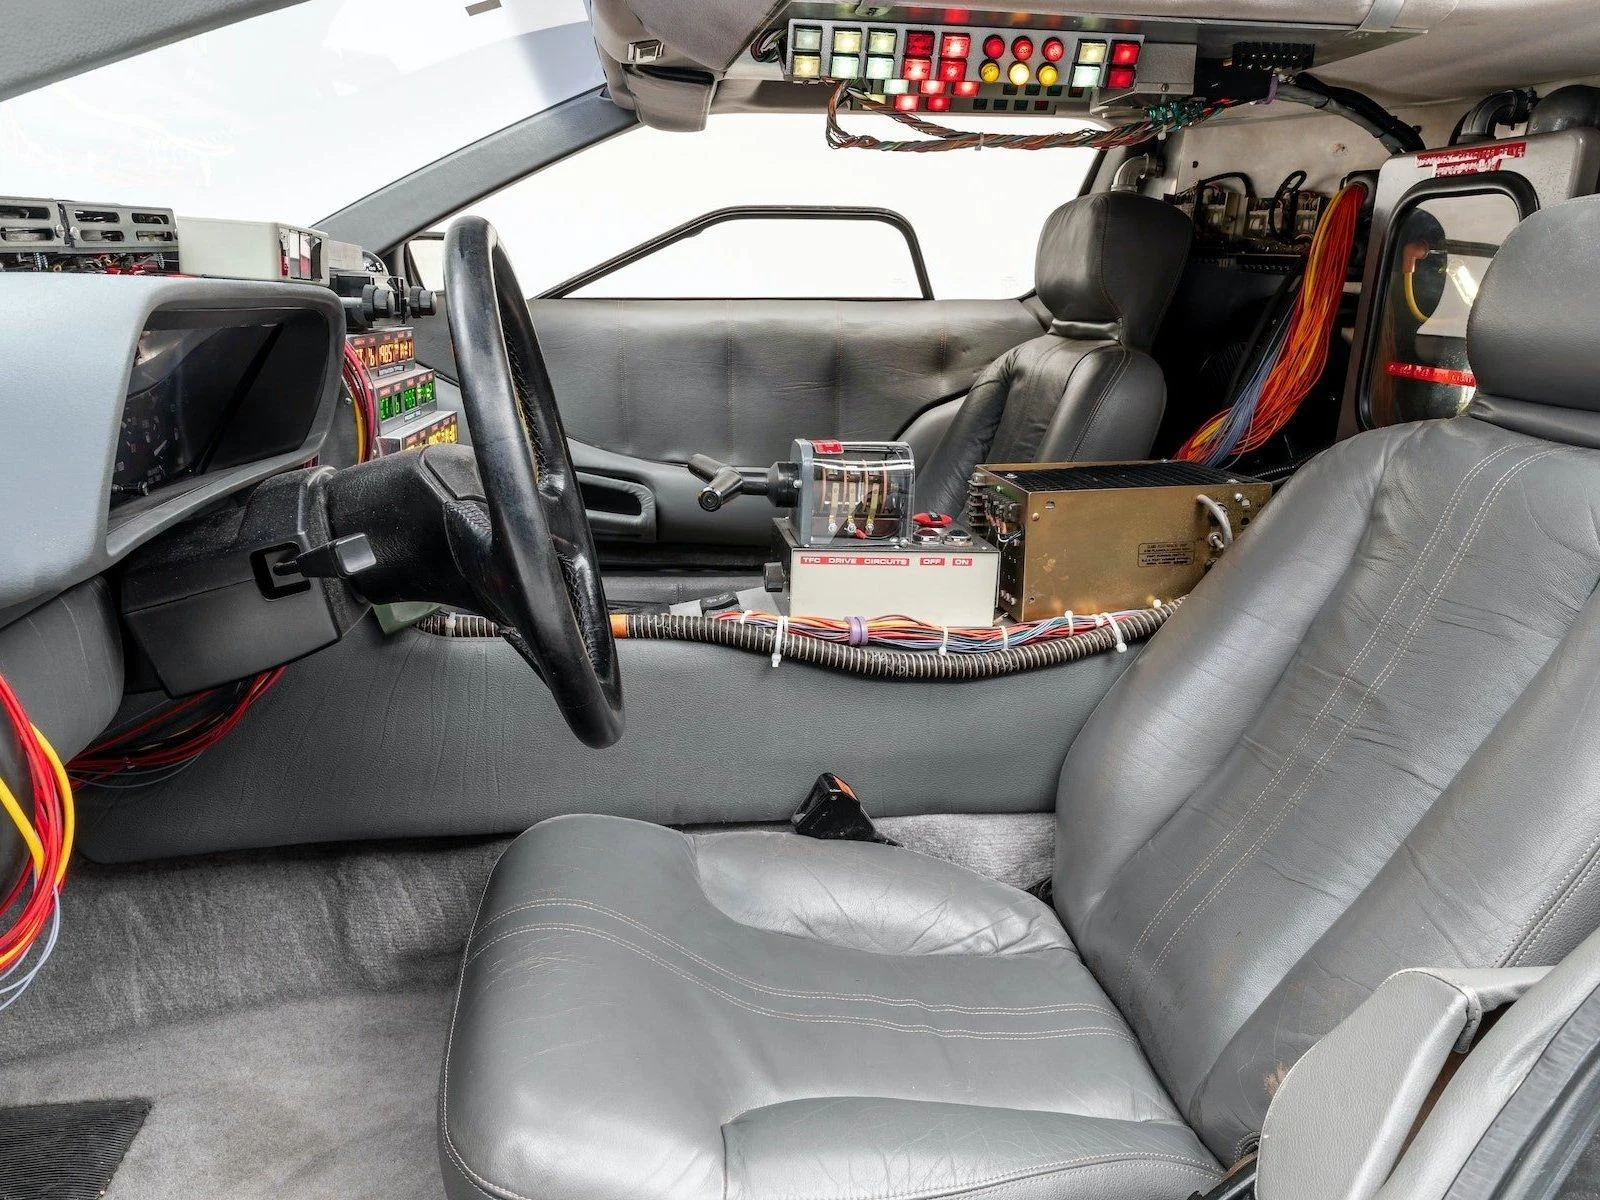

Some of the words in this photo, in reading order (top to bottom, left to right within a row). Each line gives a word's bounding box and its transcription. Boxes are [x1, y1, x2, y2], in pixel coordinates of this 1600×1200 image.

[828, 557, 857, 565] DRIVE
[863, 558, 908, 566] CIRCUITS
[922, 558, 941, 566] OFF
